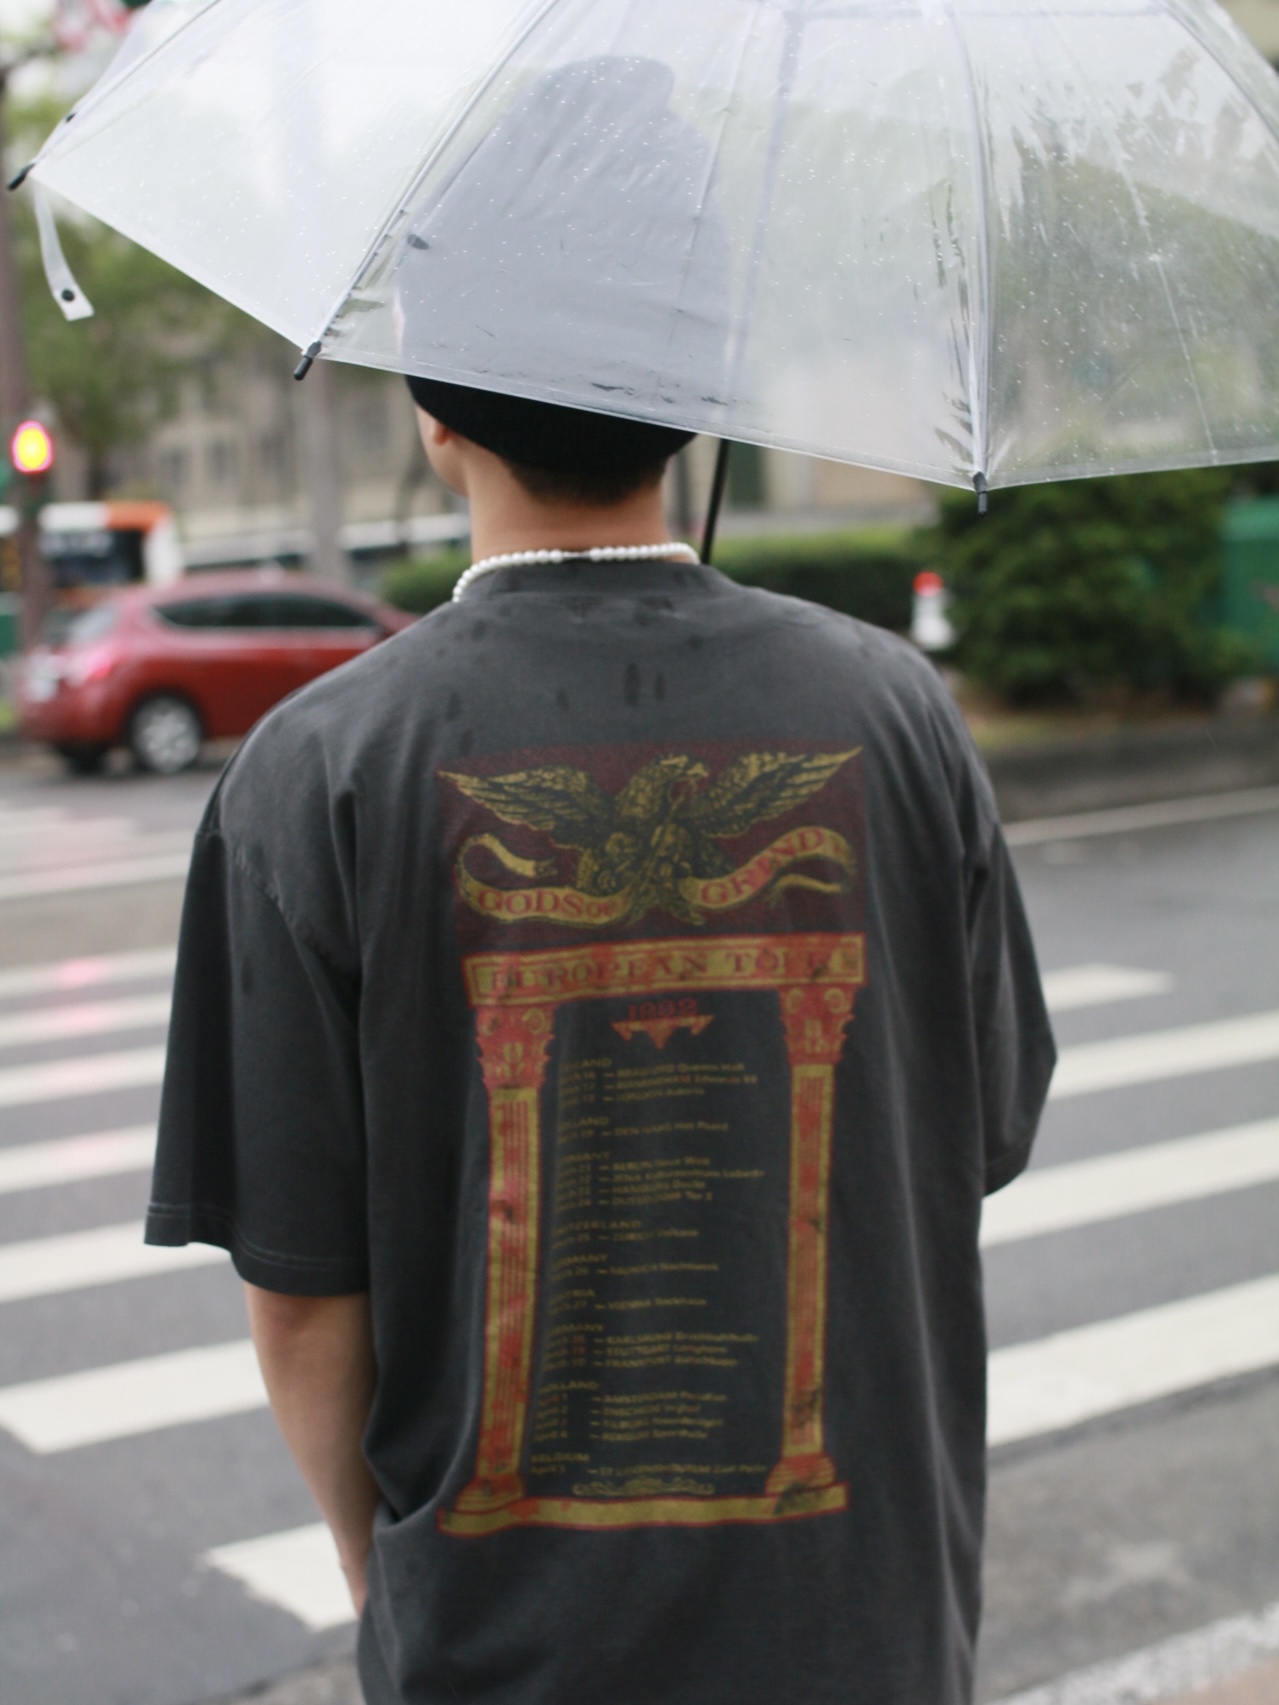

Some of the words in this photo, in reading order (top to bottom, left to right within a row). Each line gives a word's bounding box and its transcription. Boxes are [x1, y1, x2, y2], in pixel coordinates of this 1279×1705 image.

[478, 889, 584, 918] GODS
[702, 826, 825, 905] GRIND
[491, 954, 708, 991] EUROPEAN
[724, 948, 833, 975] TOUR
[629, 998, 698, 1020] 1992
